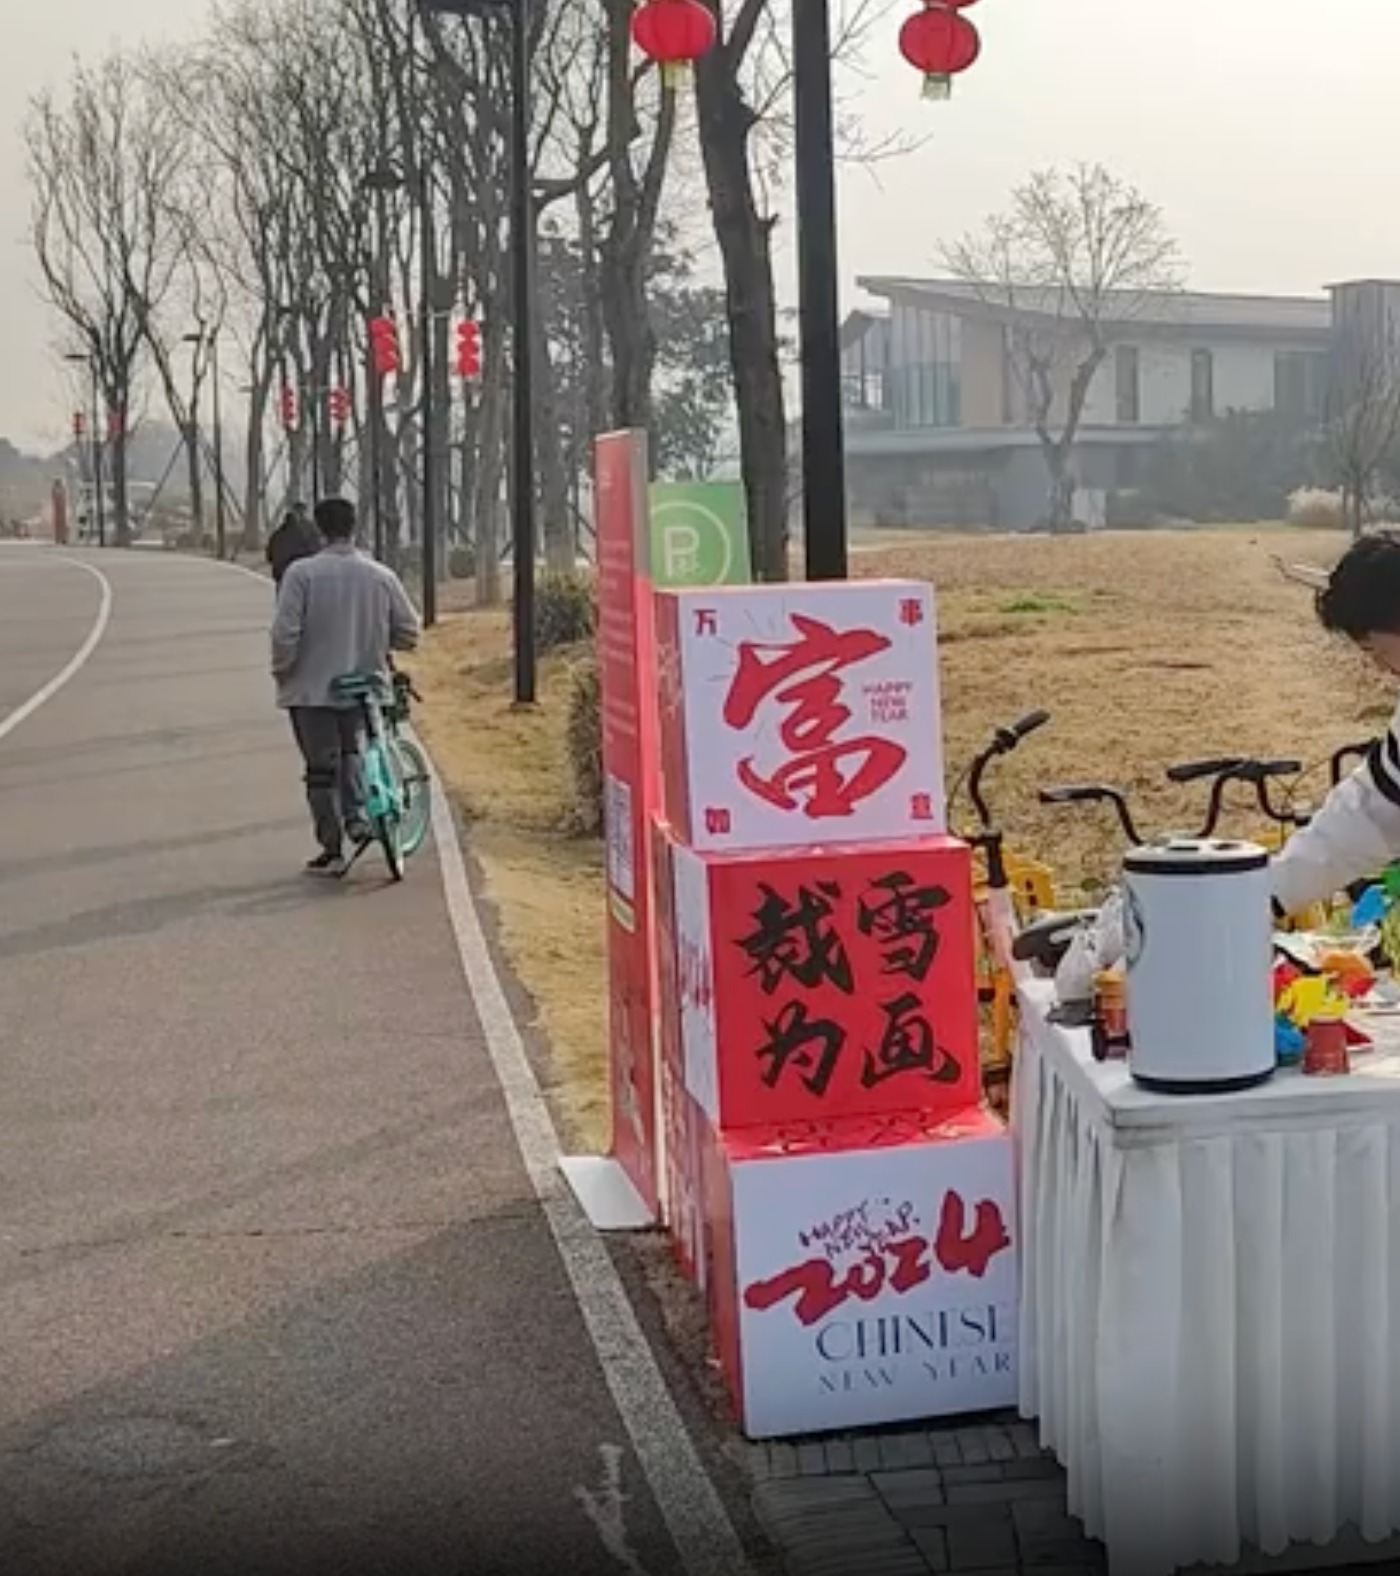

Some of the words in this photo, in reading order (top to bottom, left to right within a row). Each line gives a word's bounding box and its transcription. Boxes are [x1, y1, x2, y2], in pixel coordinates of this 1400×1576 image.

[694, 608, 718, 636] 万
[862, 681, 913, 696] HAPPY
[732, 870, 952, 994] 裁雪
[756, 994, 962, 1096] 为画
[745, 1188, 1011, 1326] 2024
